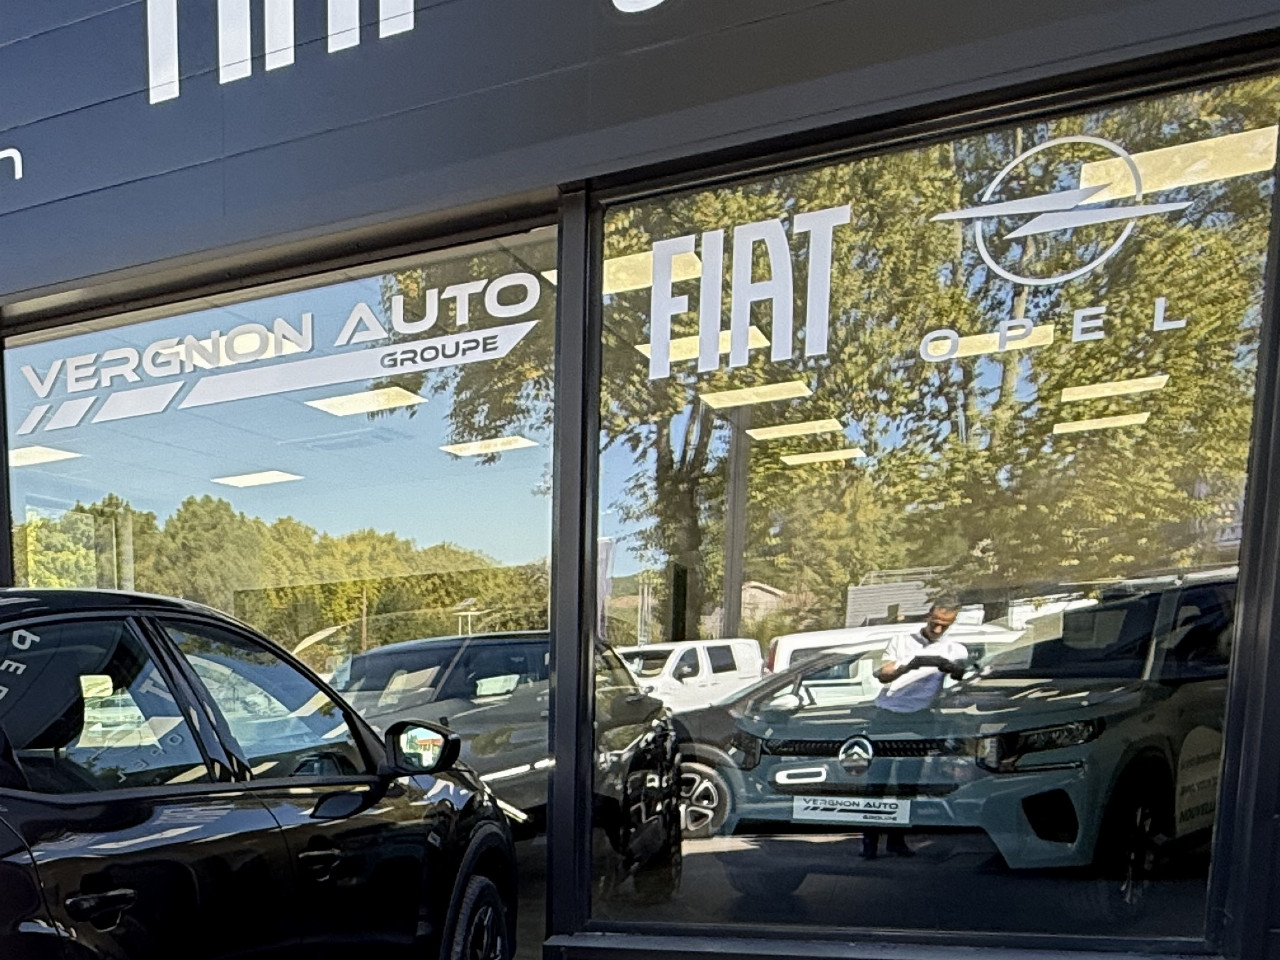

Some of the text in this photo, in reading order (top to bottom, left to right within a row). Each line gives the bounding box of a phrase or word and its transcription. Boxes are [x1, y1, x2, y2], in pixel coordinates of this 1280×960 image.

[648, 203, 851, 380] FIAT
[20, 273, 541, 398] VERGNON AUTO
[380, 334, 499, 369] GROUPE
[921, 296, 1188, 363] OPEL
[803, 798, 899, 810] VERGNON AUTO
